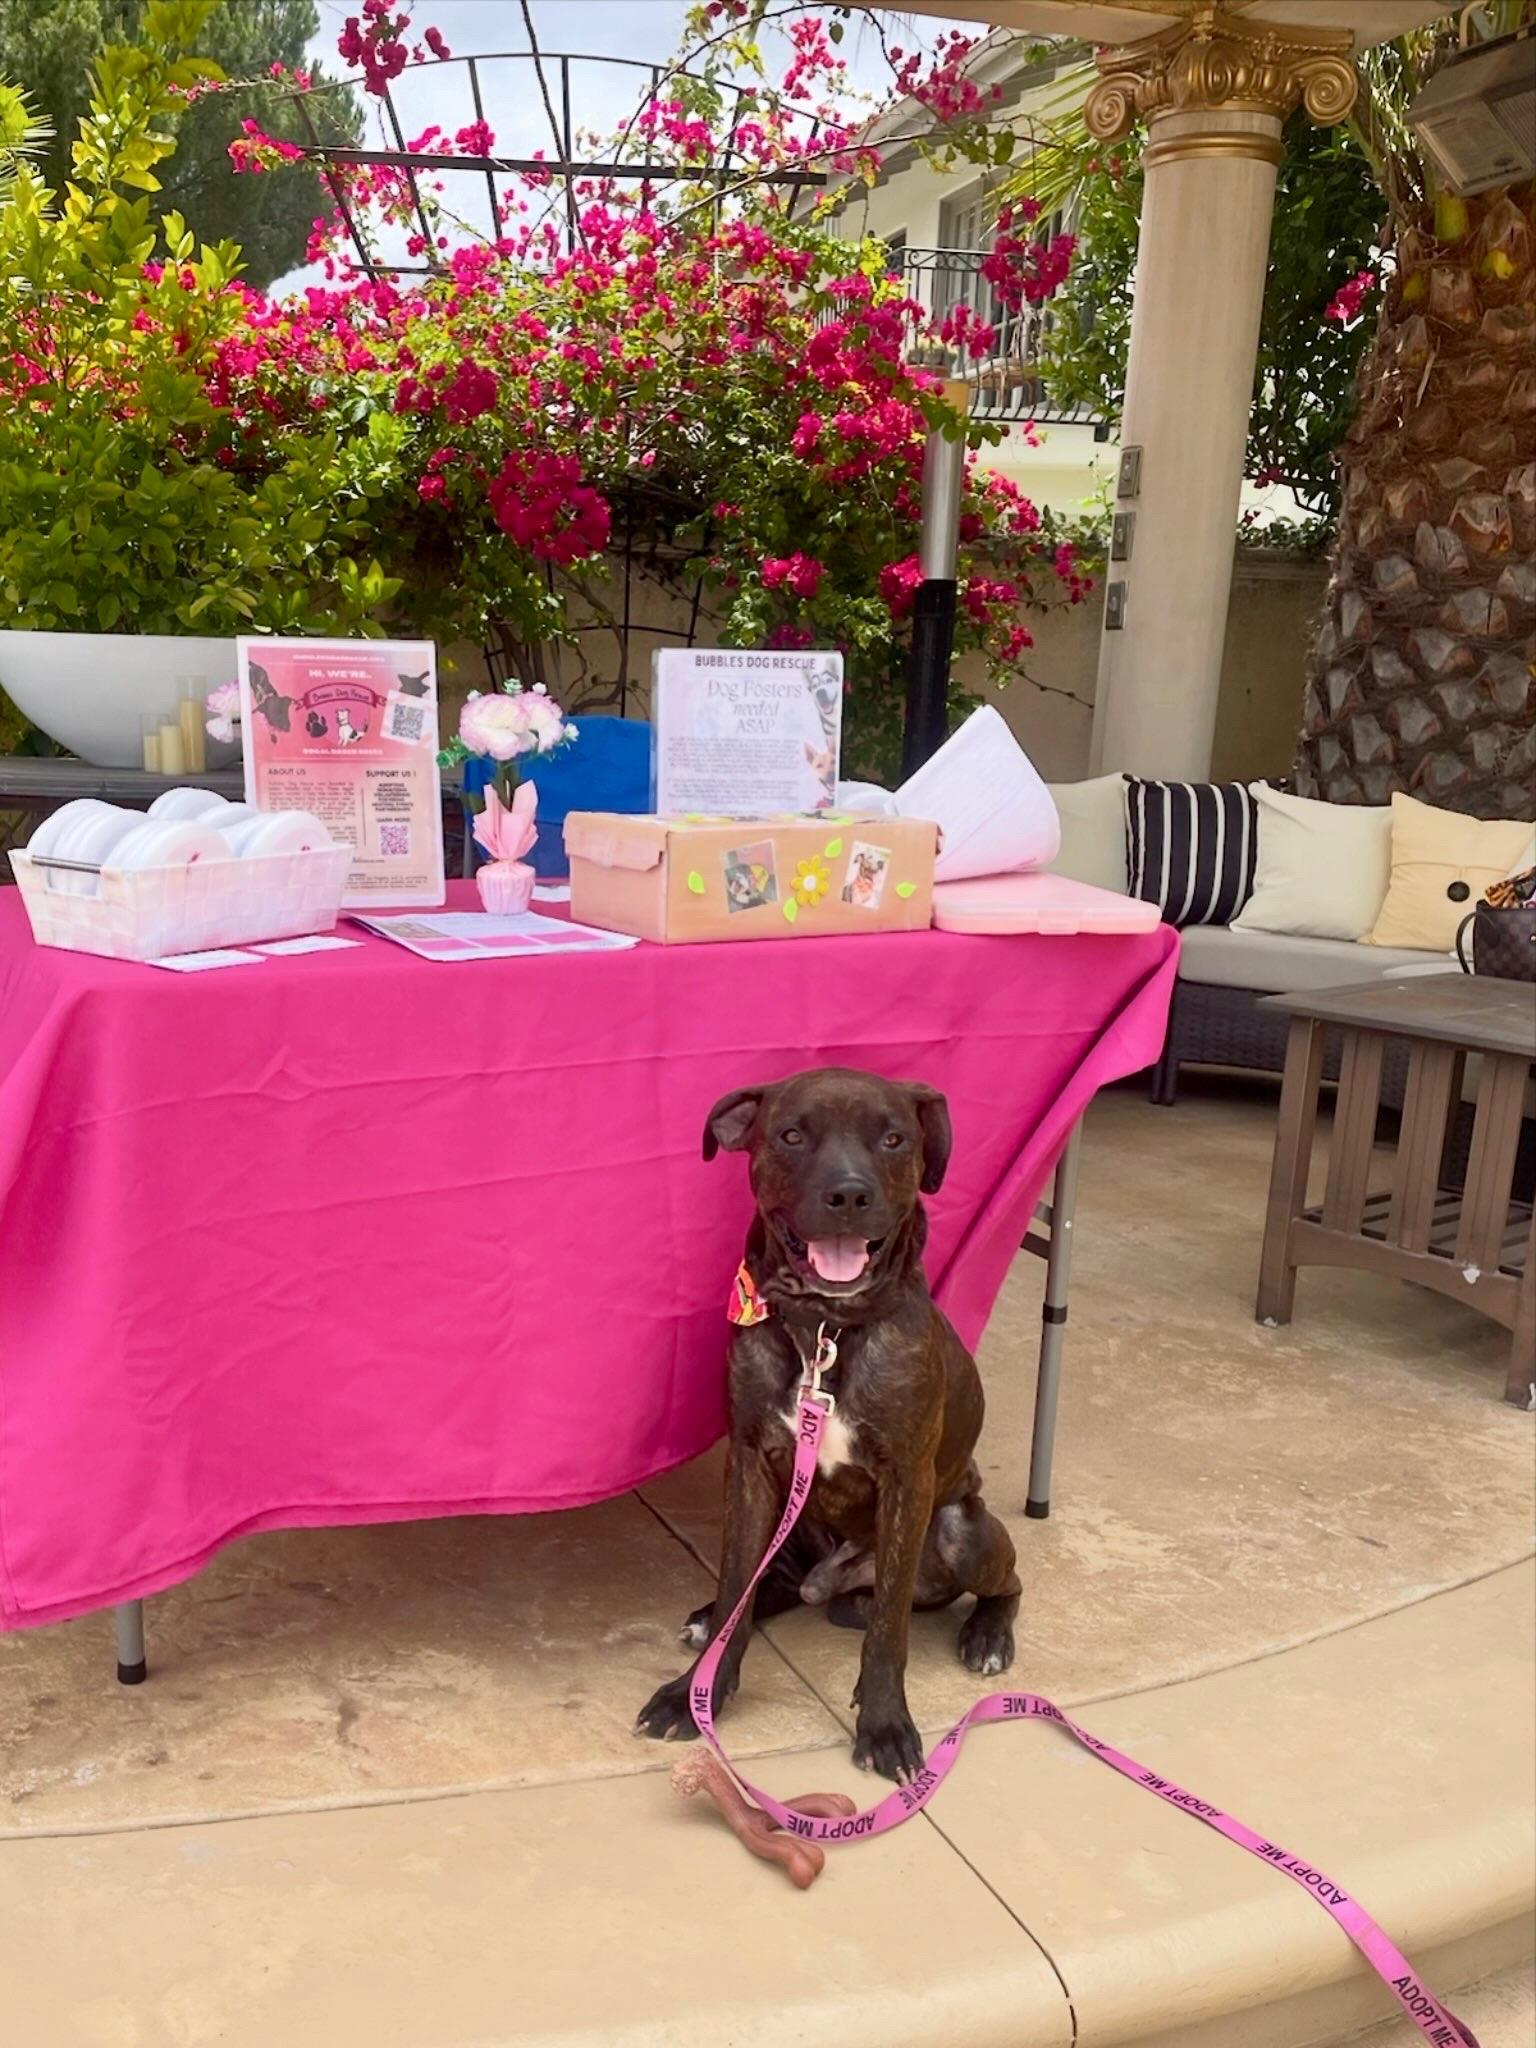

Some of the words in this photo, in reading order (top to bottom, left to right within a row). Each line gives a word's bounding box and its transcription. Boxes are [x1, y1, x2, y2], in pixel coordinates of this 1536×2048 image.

[695, 655, 743, 668] BUBBLES
[747, 656, 769, 669] DOG
[773, 657, 816, 670] RESCUE
[708, 680, 741, 702] Dog
[744, 681, 803, 698] Fosters
[733, 701, 780, 717] needed
[736, 719, 776, 734] ASAP
[268, 768, 294, 776] ABOUT
[366, 770, 399, 778] SUPPORT
[793, 1469, 809, 1499] ME
[694, 1686, 709, 1713] ME
[1003, 1697, 1027, 1714] ME
[1139, 1772, 1168, 1790] ME
[1165, 1787, 1224, 1818] ADOPT
[786, 1814, 814, 1838] ME
[817, 1812, 876, 1839] ADOPT
[1255, 1842, 1288, 1861] ME
[1282, 1859, 1348, 1905] ADOPT
[1391, 1976, 1442, 2028] ADOPT
[1430, 2026, 1457, 2048] ME
